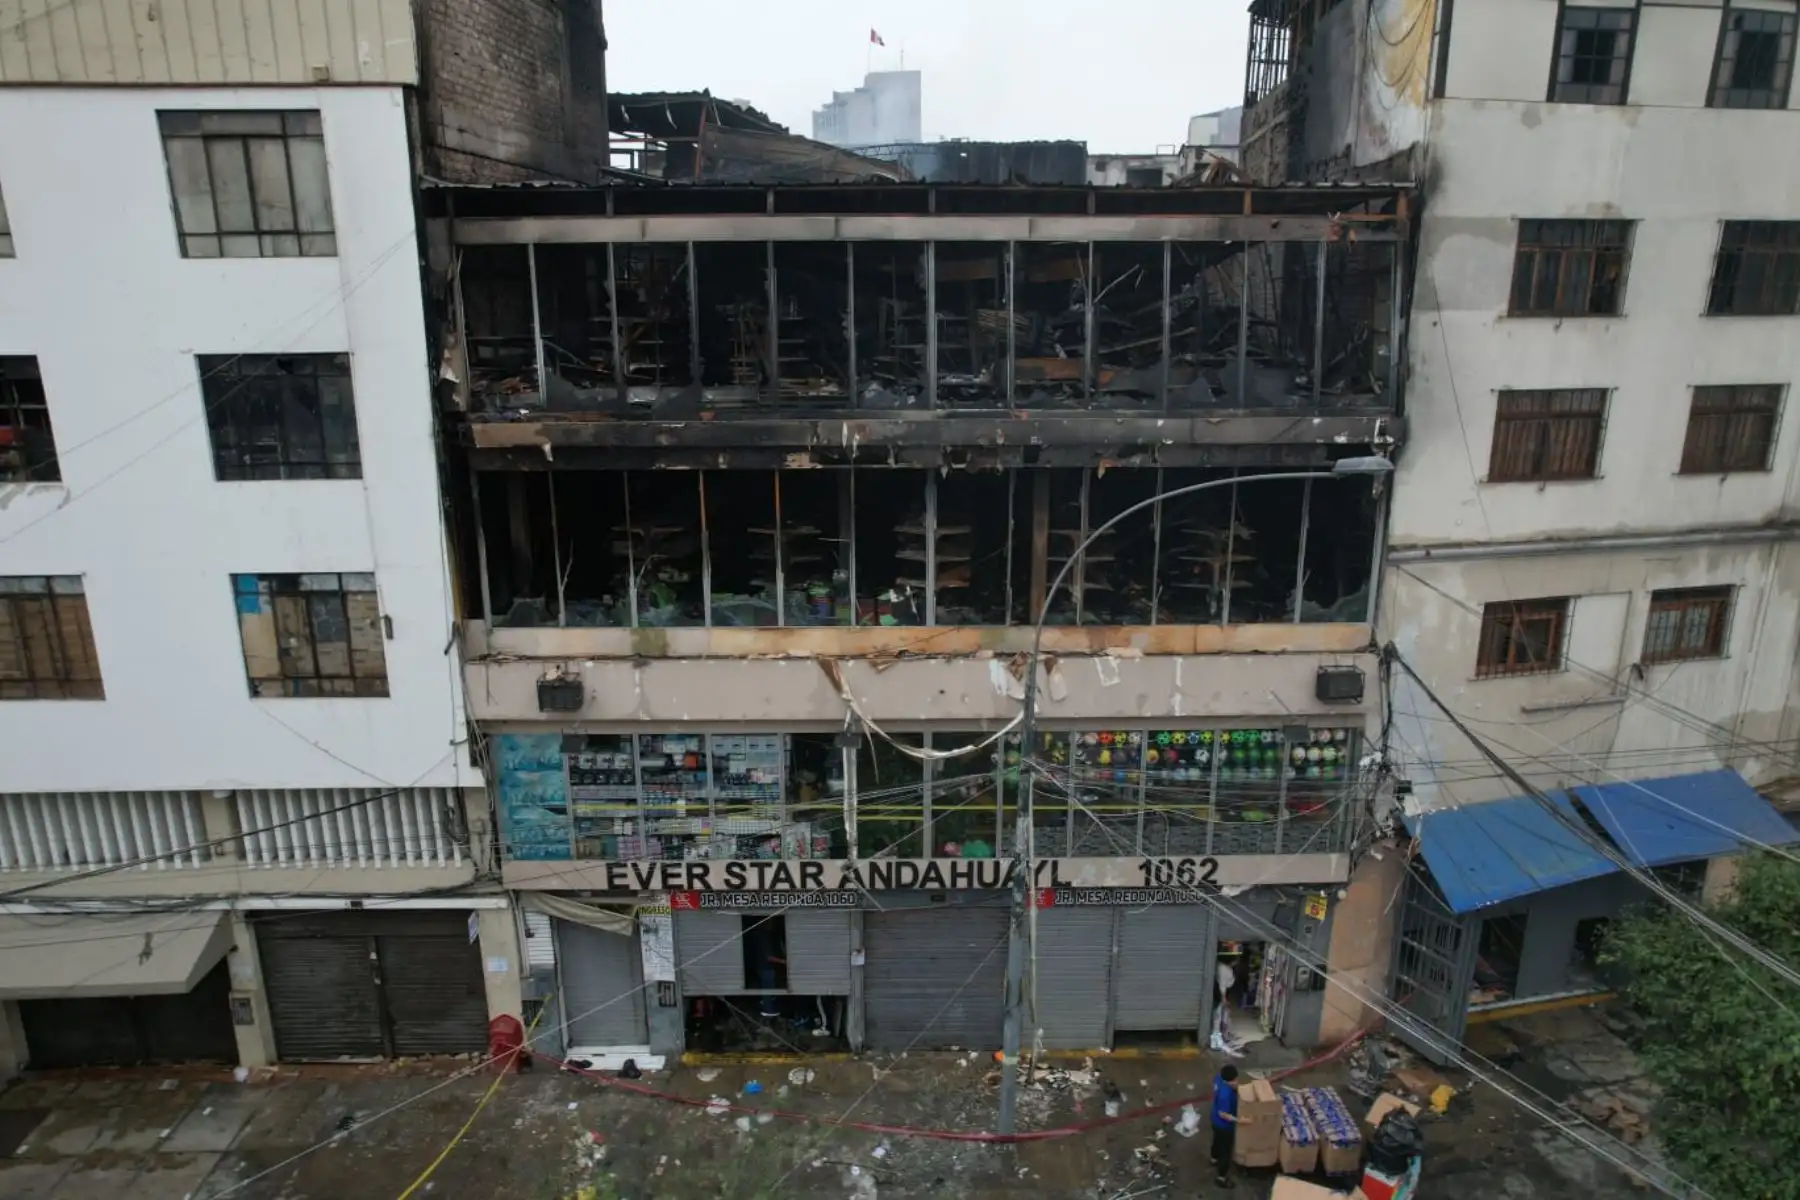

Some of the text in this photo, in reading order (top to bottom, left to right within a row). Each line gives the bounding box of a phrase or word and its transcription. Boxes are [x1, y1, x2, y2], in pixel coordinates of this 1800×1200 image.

[605, 862, 710, 890] EVER
[723, 861, 824, 890] STAR
[1138, 857, 1219, 887] 1062
[721, 892, 760, 907] MESA
[761, 891, 823, 907] REDONDA
[824, 891, 857, 906] 1060
[1076, 889, 1112, 904] MESA
